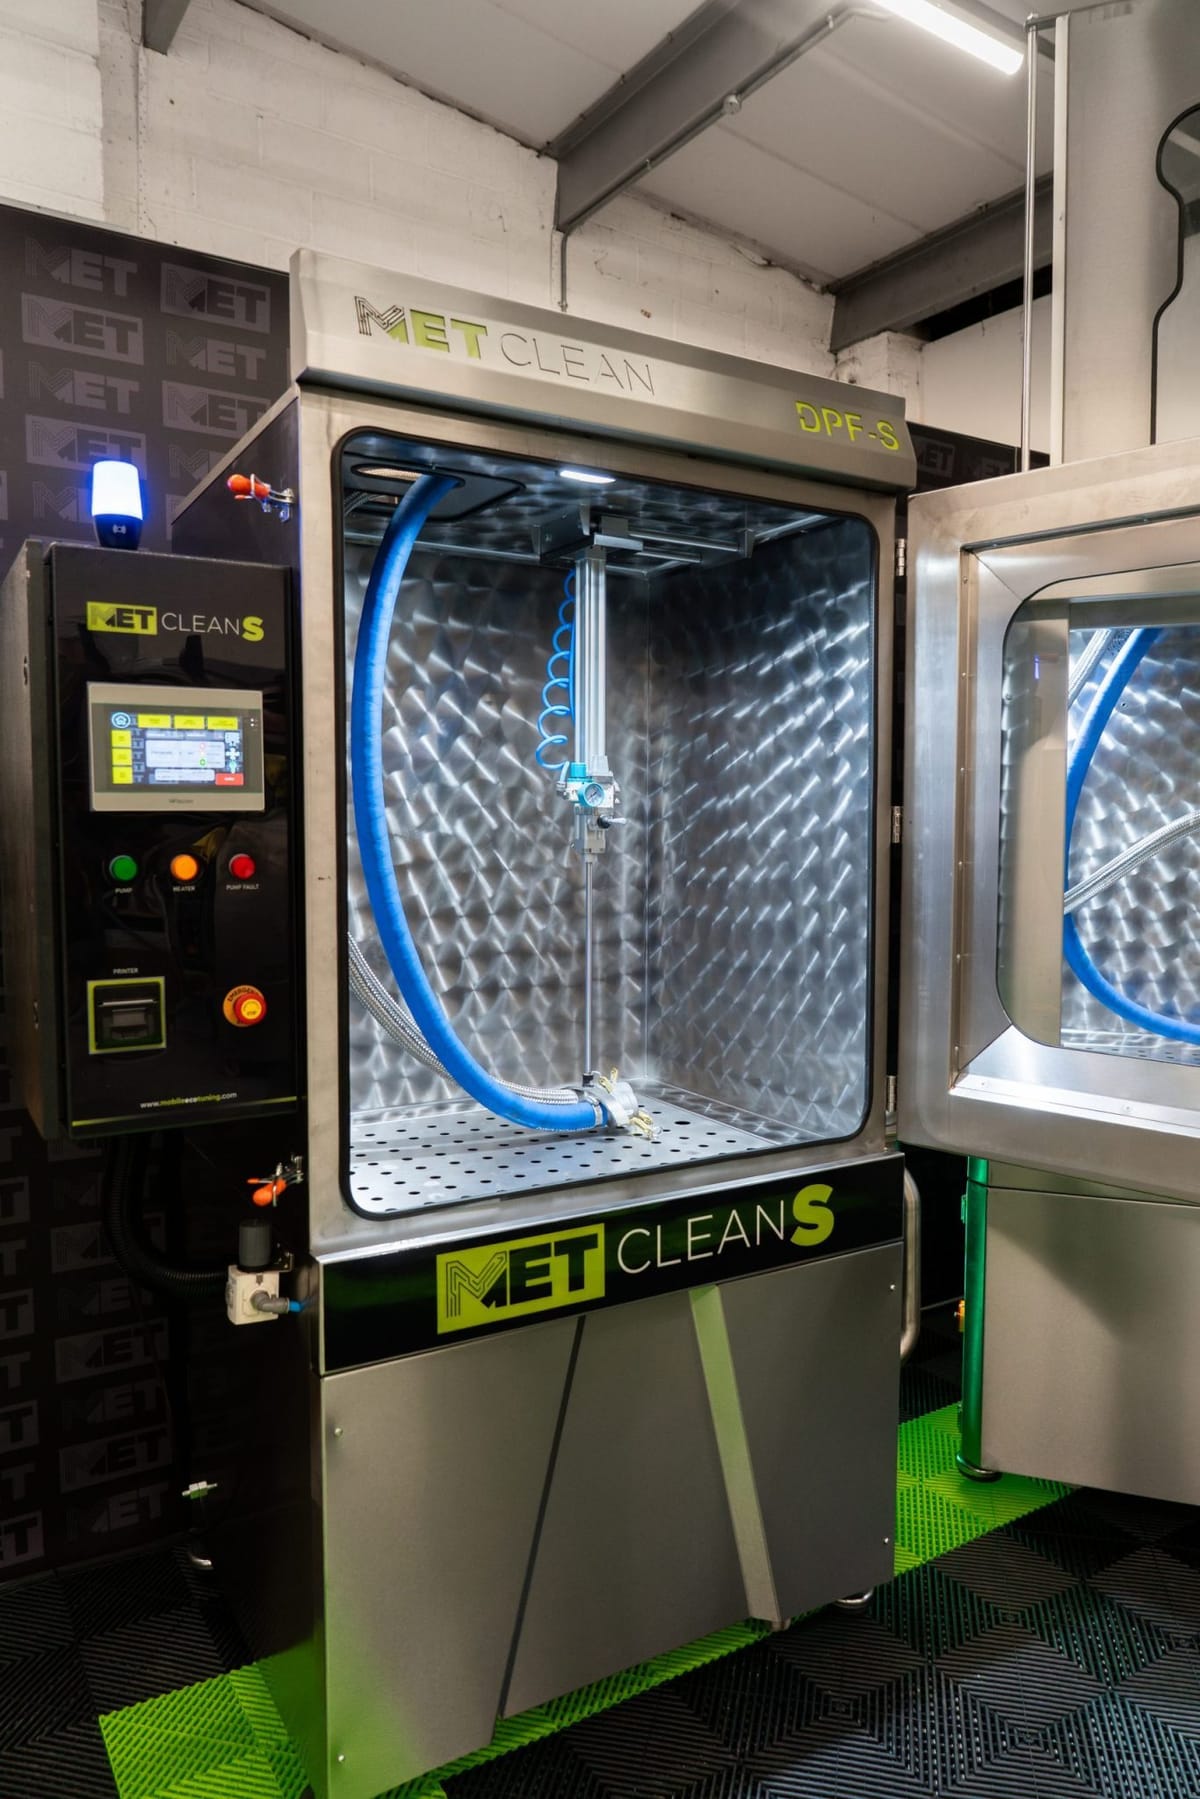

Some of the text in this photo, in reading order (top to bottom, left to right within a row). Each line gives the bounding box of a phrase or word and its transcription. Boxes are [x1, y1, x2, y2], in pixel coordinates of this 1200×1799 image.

[25, 238, 138, 296] MET
[167, 269, 266, 323] MET
[27, 299, 138, 355] MET
[354, 296, 655, 396] MET CLEAN
[166, 329, 266, 380] MET
[29, 361, 139, 414] MET
[796, 400, 900, 451] DPF-S
[90, 604, 154, 630] MET
[112, 967, 139, 975] PRINTER
[444, 1233, 598, 1318] MET
[65, 1429, 168, 1484] MET
